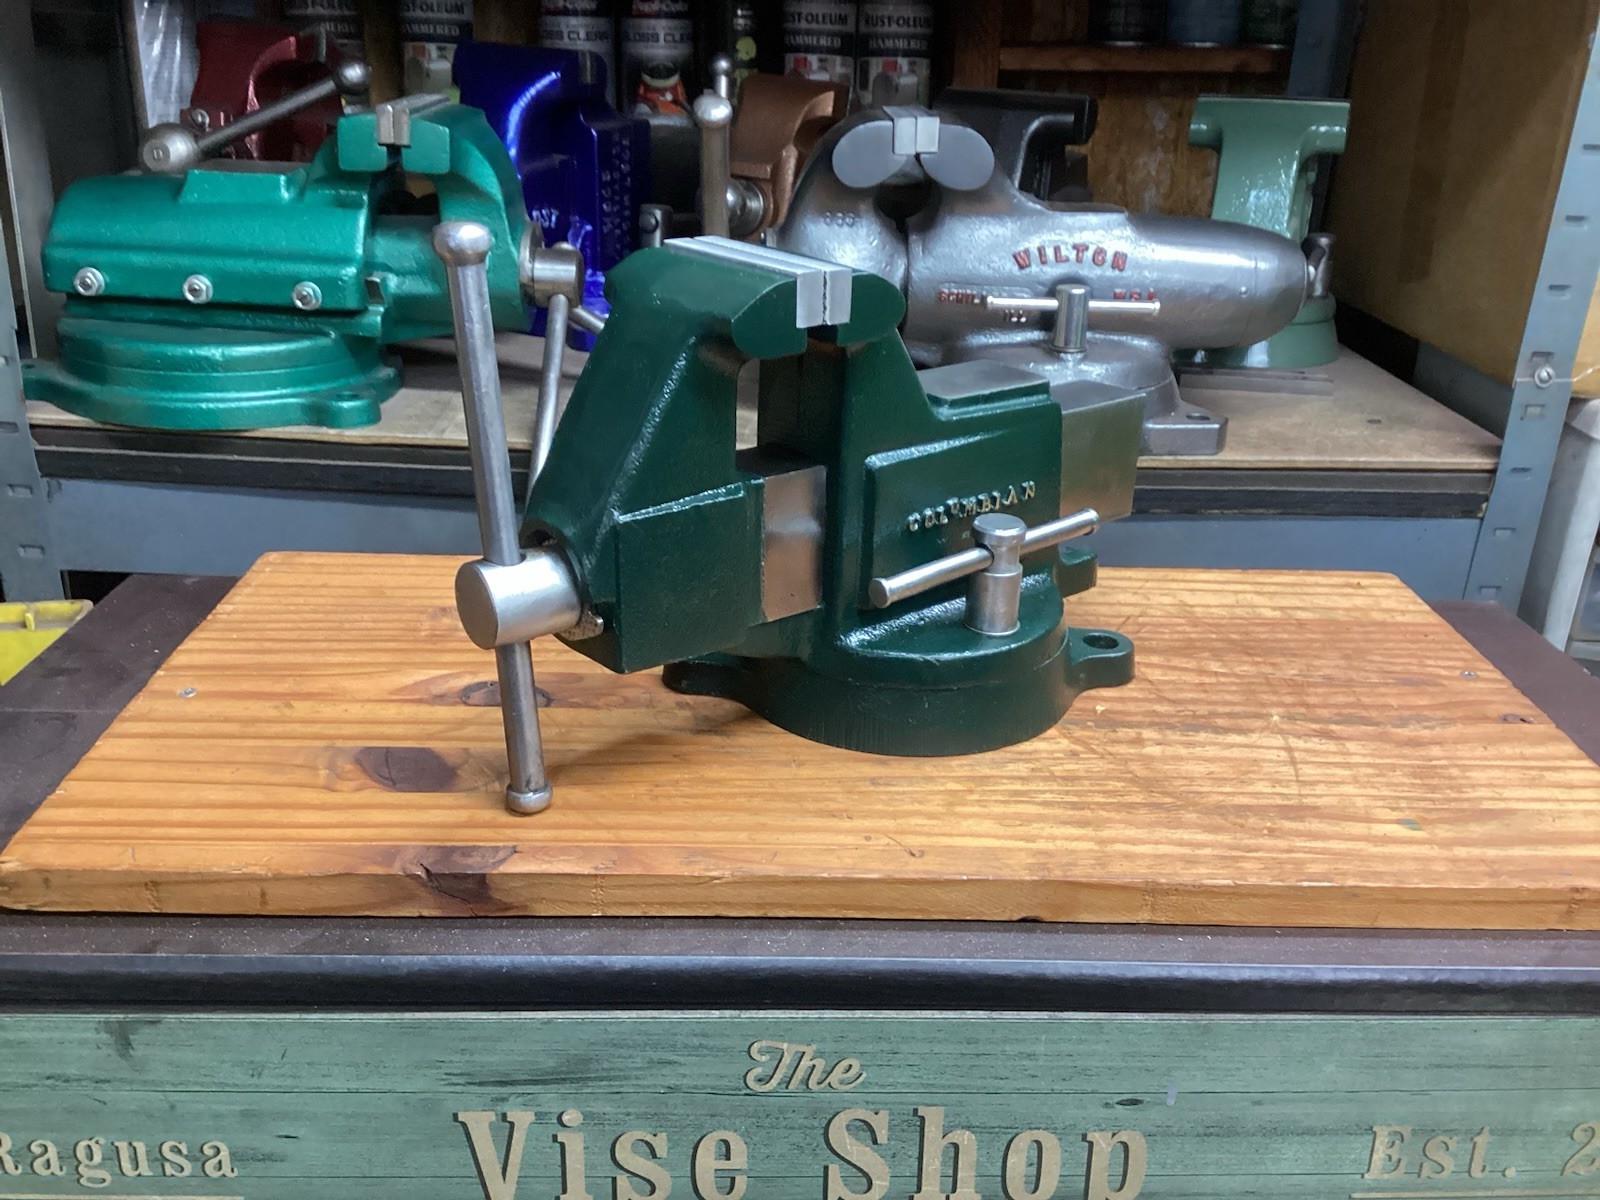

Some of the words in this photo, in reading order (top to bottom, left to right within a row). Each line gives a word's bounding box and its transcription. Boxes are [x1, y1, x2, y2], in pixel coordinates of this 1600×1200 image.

[1012, 242, 1128, 272] WILTON
[906, 480, 1036, 532] COLUMBIAN
[742, 1038, 867, 1093] The
[452, 1108, 749, 1200] Vise
[823, 1105, 1149, 1200] Shop
[1361, 1123, 1517, 1179] Est.
